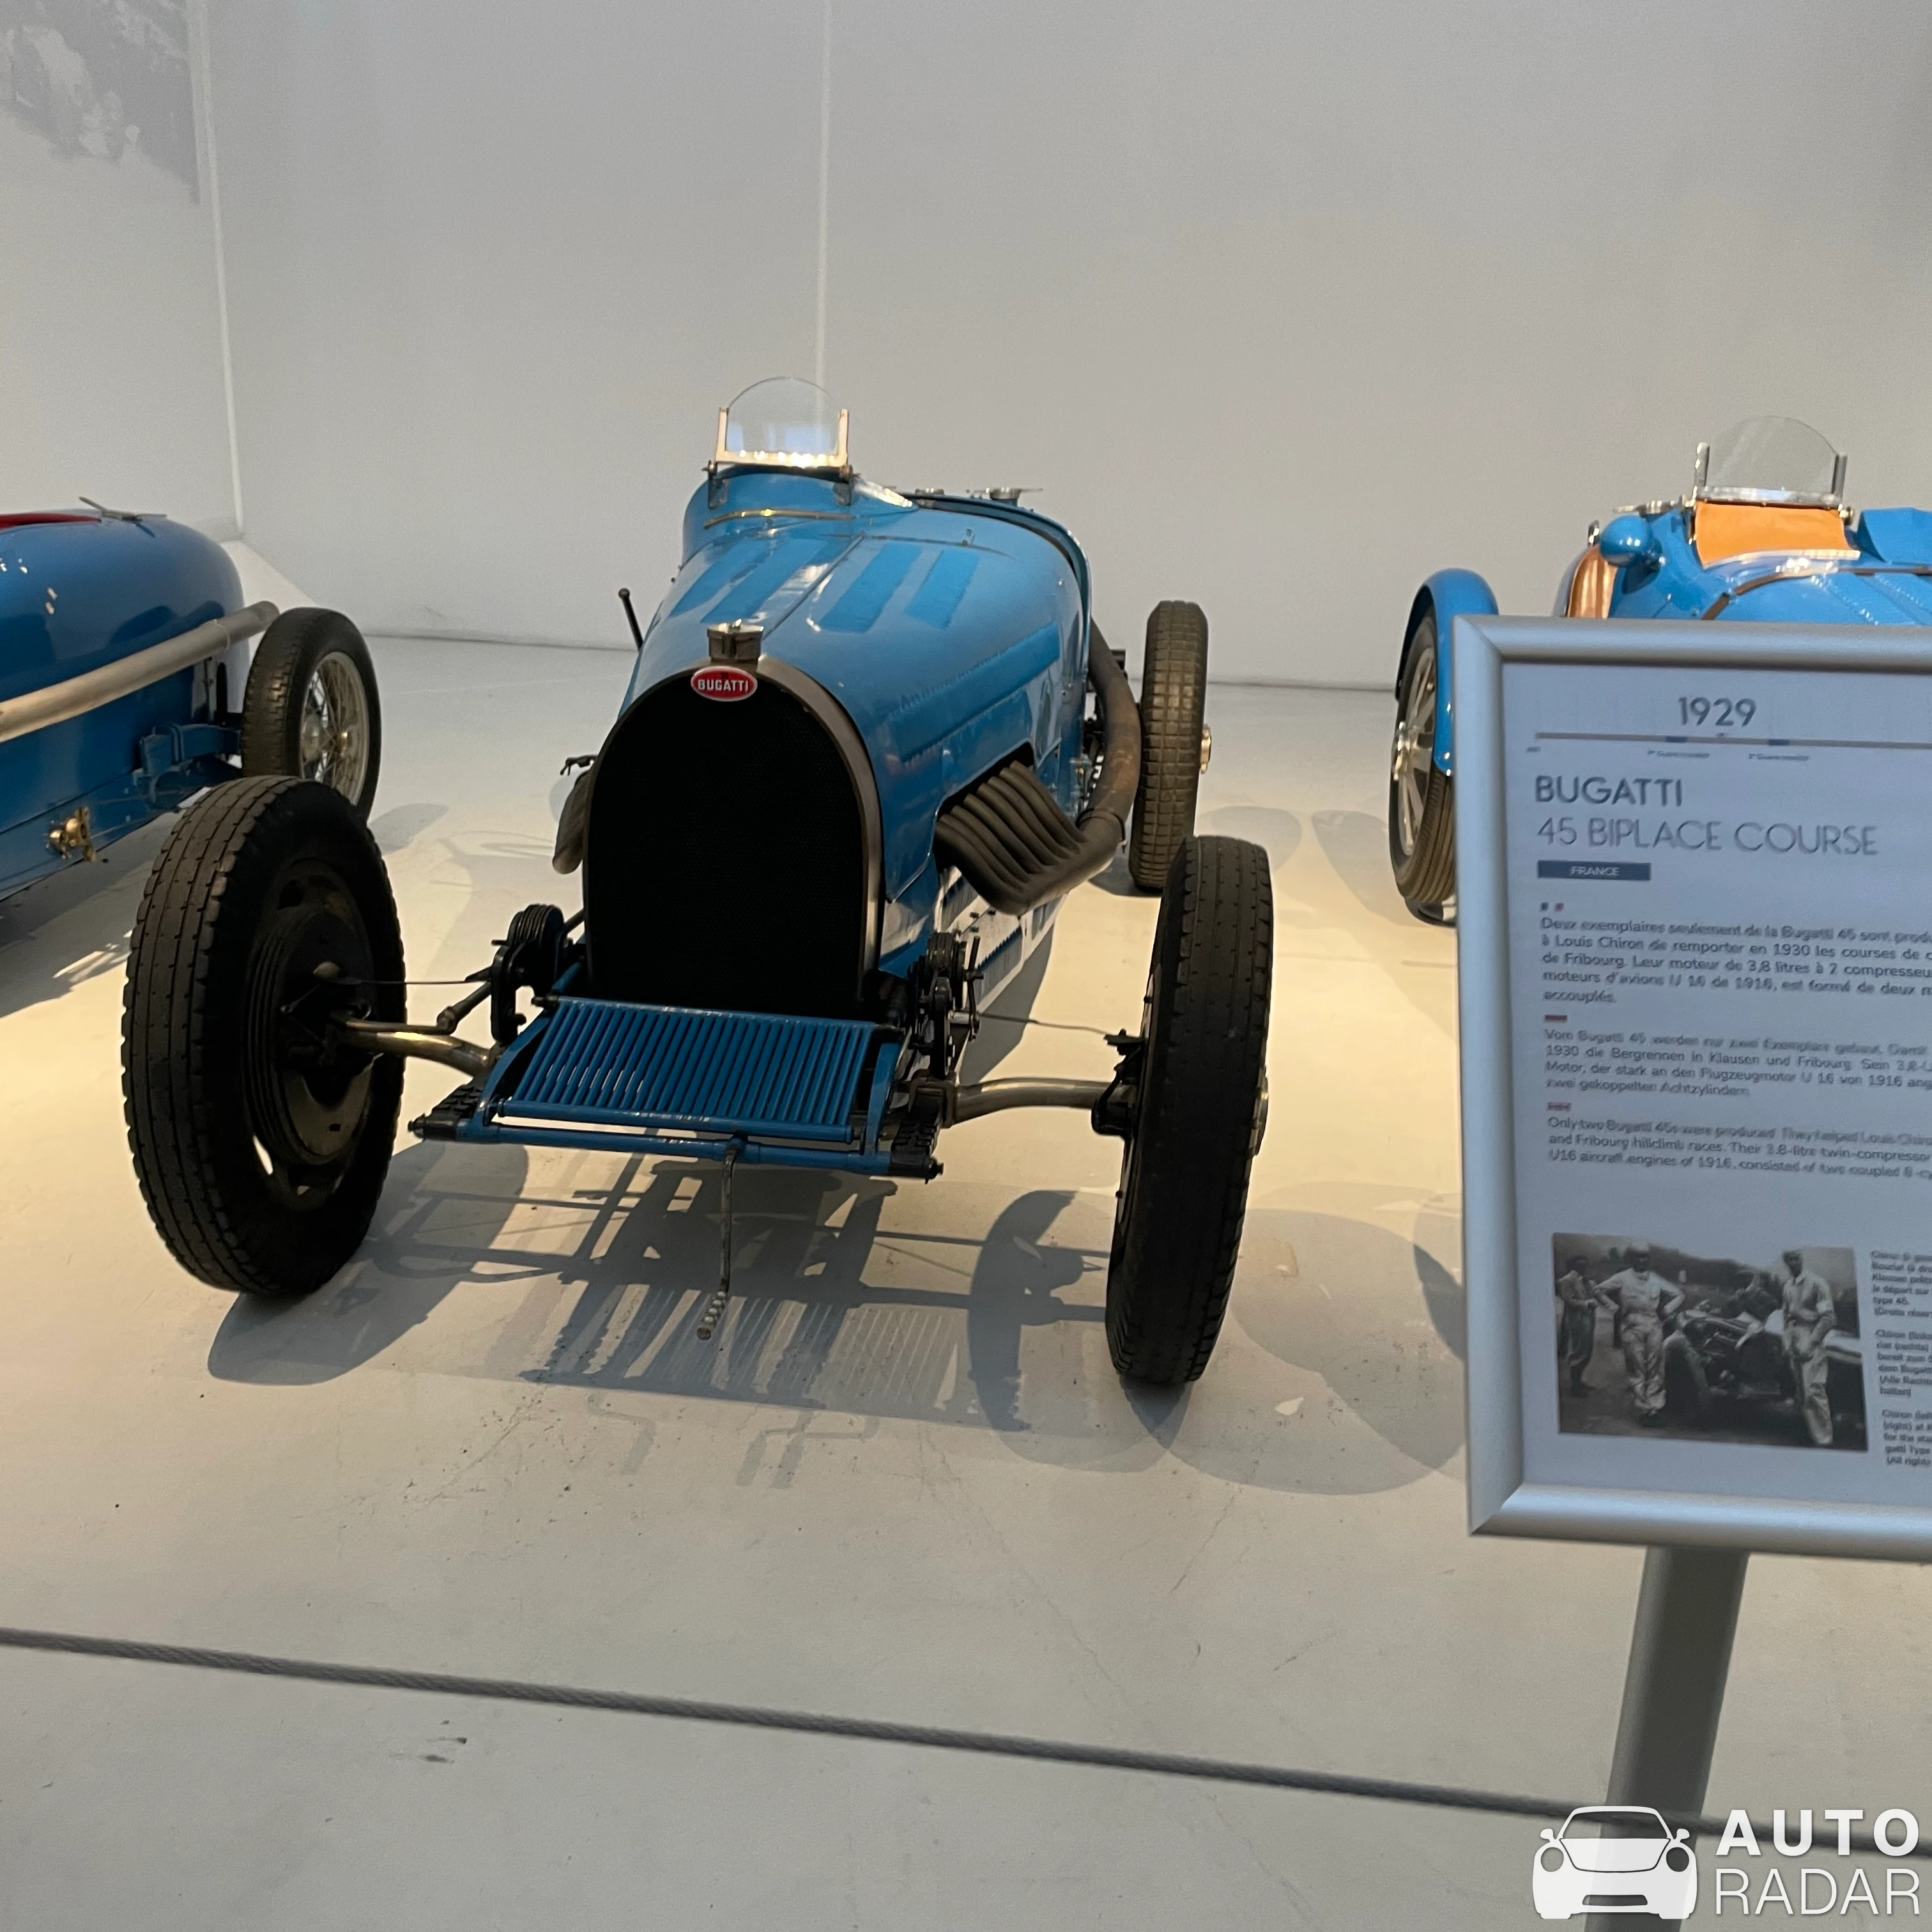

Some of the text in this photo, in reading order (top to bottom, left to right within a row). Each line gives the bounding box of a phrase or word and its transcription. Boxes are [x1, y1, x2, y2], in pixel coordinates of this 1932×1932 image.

[698, 678, 749, 693] BUGATTI
[1678, 696, 1758, 727] 1929
[1535, 775, 1683, 807] BUGATTI
[1537, 816, 1880, 856] 45 BIPLACE COURSE
[1570, 865, 1621, 877] FRANCE
[1541, 917, 1576, 929] Deux
[1581, 920, 1666, 933] exemplaires
[1668, 923, 1741, 936] seulement
[1542, 935, 1550, 946] à
[1555, 935, 1593, 947] Louis
[1598, 937, 1644, 949] Chiron
[1672, 940, 1744, 954] remporter
[1750, 945, 1767, 954] en
[1773, 943, 1811, 957] 1930
[1815, 944, 1836, 957] les
[1841, 947, 1896, 960] courses
[1903, 947, 1920, 960] de
[1543, 952, 1559, 963] de
[1565, 952, 1627, 969] Fribourg.
[1632, 955, 1665, 968] Leur
[1669, 958, 1720, 970] moteur
[1726, 959, 1743, 970] de
[1748, 960, 1771, 973] 3,8
[1775, 961, 1811, 974] litres
[1816, 962, 1823, 974] à
[1543, 970, 1600, 983] moteurs
[1857, 981, 1875, 993] de
[1880, 982, 1915, 995] deux
[1546, 1045, 1579, 1057] 1930
[1586, 1046, 1604, 1057] die
[1611, 1047, 1685, 1062] Bergrennen
[1691, 1050, 1703, 1062] in
[1710, 1051, 1759, 1066] Klausen
[1767, 1054, 1790, 1066] und
[1862, 1058, 1890, 1070] Sein
[1545, 1061, 1586, 1074] Motor,
[1591, 1063, 1611, 1075] der
[1616, 1064, 1646, 1076] stark
[1652, 1068, 1667, 1077] an
[1672, 1066, 1696, 1078] den
[1699, 1068, 1797, 1083] Flugzeugmotor
[1818, 1073, 1834, 1084] 16
[1839, 1075, 1863, 1085] von
[1869, 1075, 1903, 1087] 1916
[1579, 1078, 1657, 1092] gekoppelten
[1548, 1116, 1577, 1130] Only
[1581, 1119, 1605, 1130] two
[1549, 1133, 1572, 1144] and
[1575, 1134, 1630, 1150] Fribourg
[1632, 1137, 1685, 1150] hillclimb
[1729, 1141, 1761, 1154] Their
[1549, 1149, 1577, 1162] U16
[1579, 1151, 1623, 1163] aircraft
[1627, 1154, 1676, 1168] engines
[1680, 1154, 1694, 1167] of
[1738, 1159, 1800, 1172] consisted
[1849, 1165, 1901, 1178] coupled
